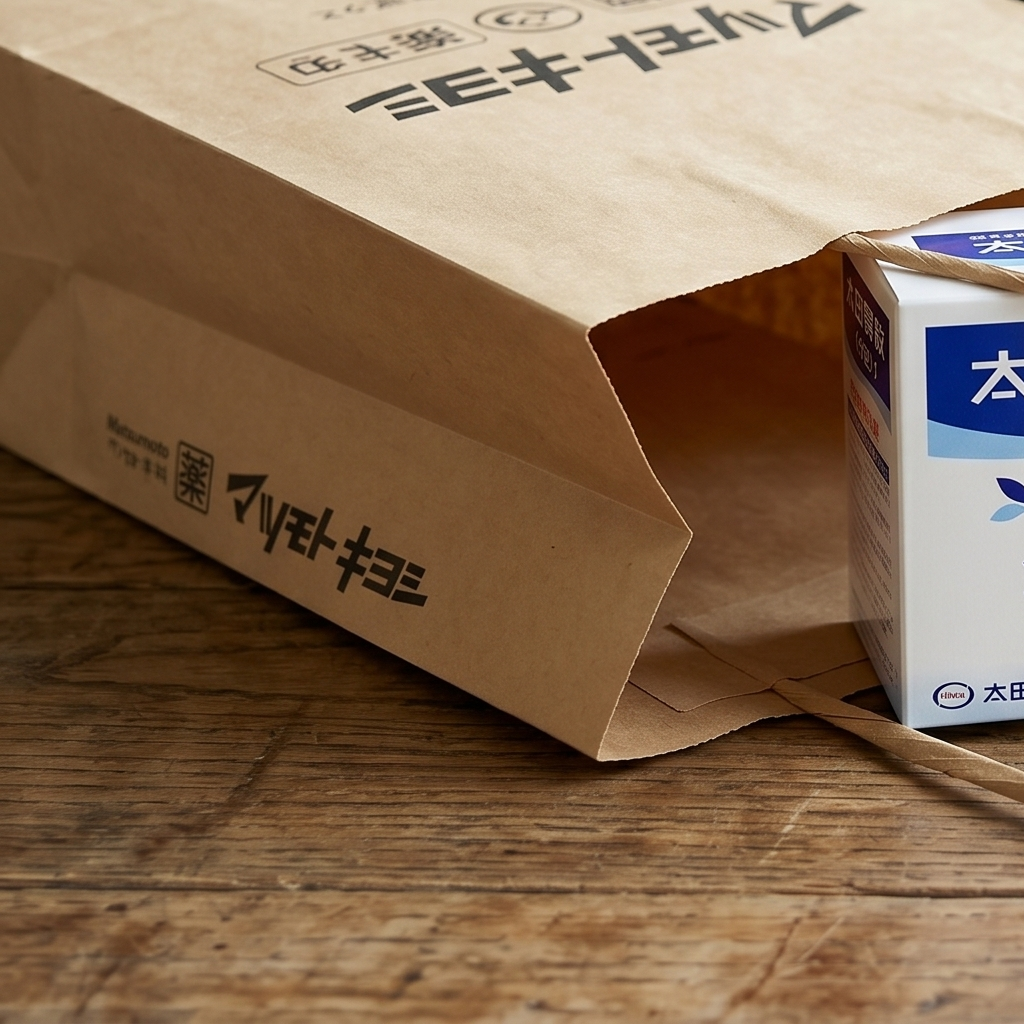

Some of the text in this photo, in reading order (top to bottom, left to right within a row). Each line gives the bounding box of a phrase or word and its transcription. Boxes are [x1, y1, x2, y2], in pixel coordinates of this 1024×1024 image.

[345, 0, 866, 121] マツモトキヨシ
[178, 449, 209, 506] 薬
[226, 473, 428, 607] マツモトキヨシ
